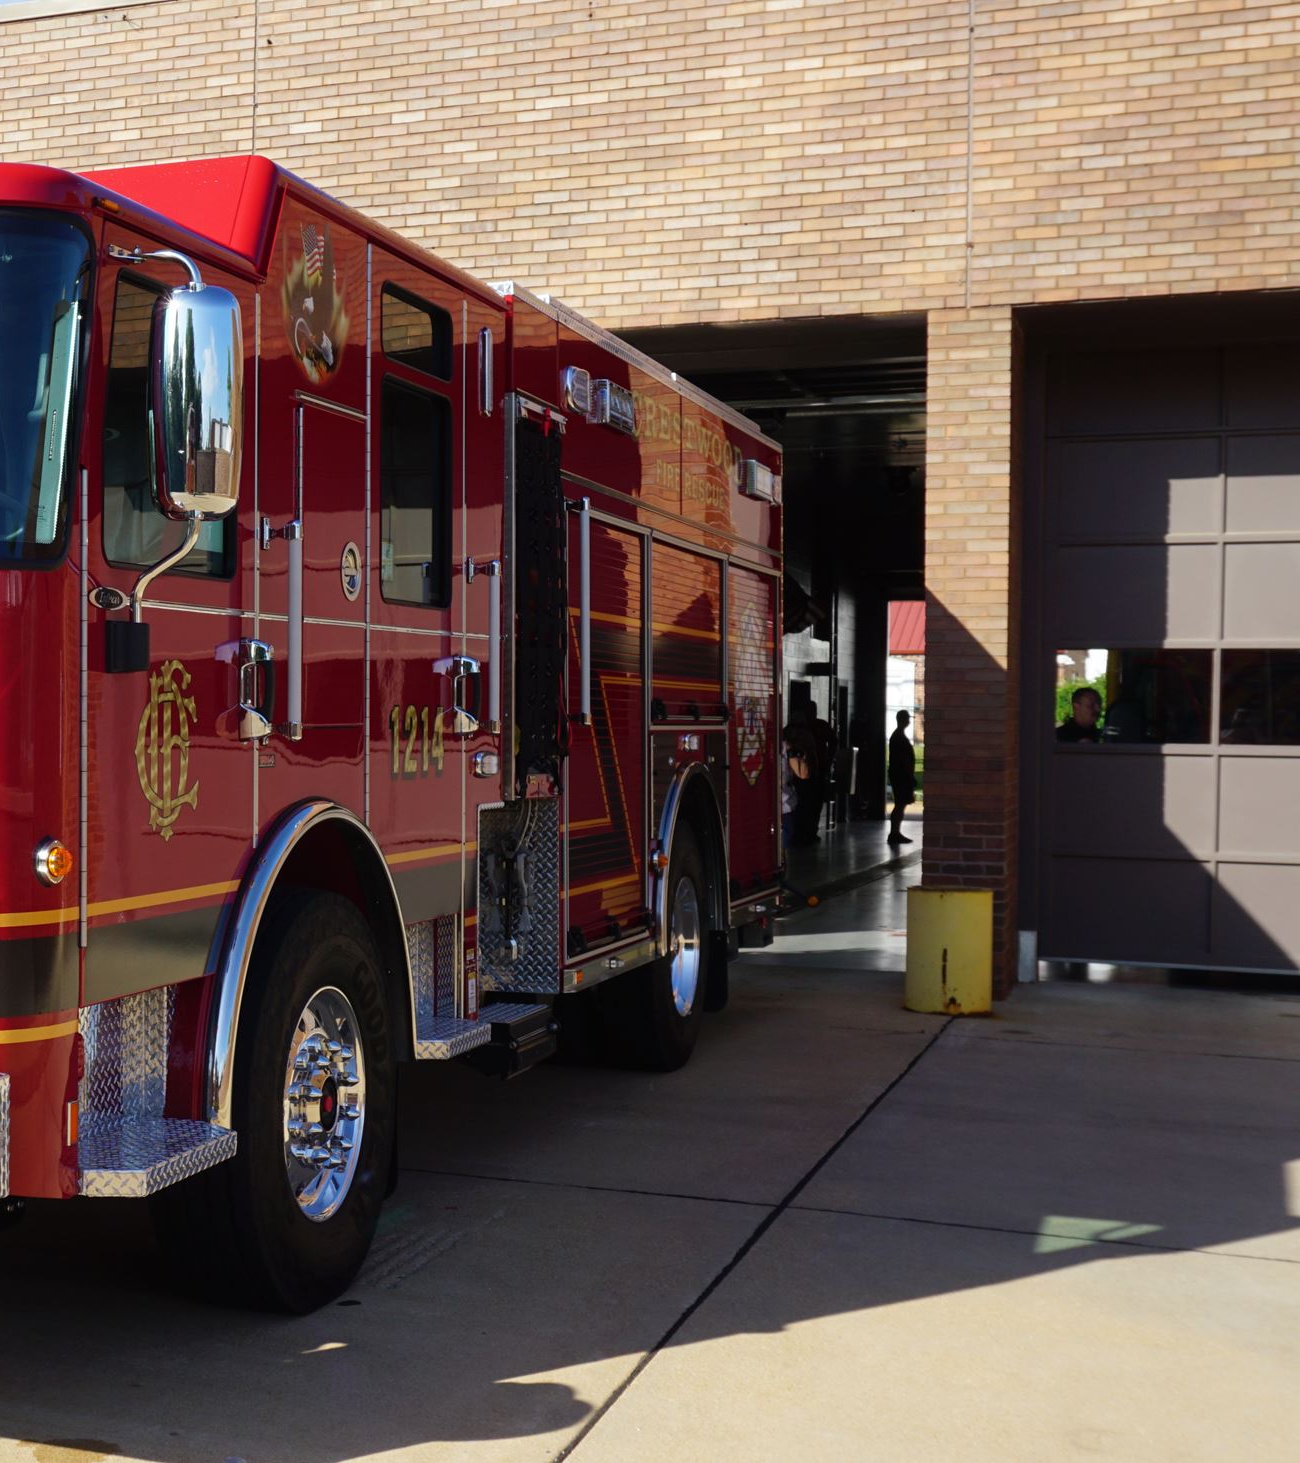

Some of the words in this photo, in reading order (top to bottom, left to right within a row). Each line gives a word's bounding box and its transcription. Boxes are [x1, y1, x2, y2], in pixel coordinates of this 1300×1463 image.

[656, 458, 679, 488] FIRE
[683, 474, 726, 509] RESCUE
[390, 704, 444, 776] 1214
